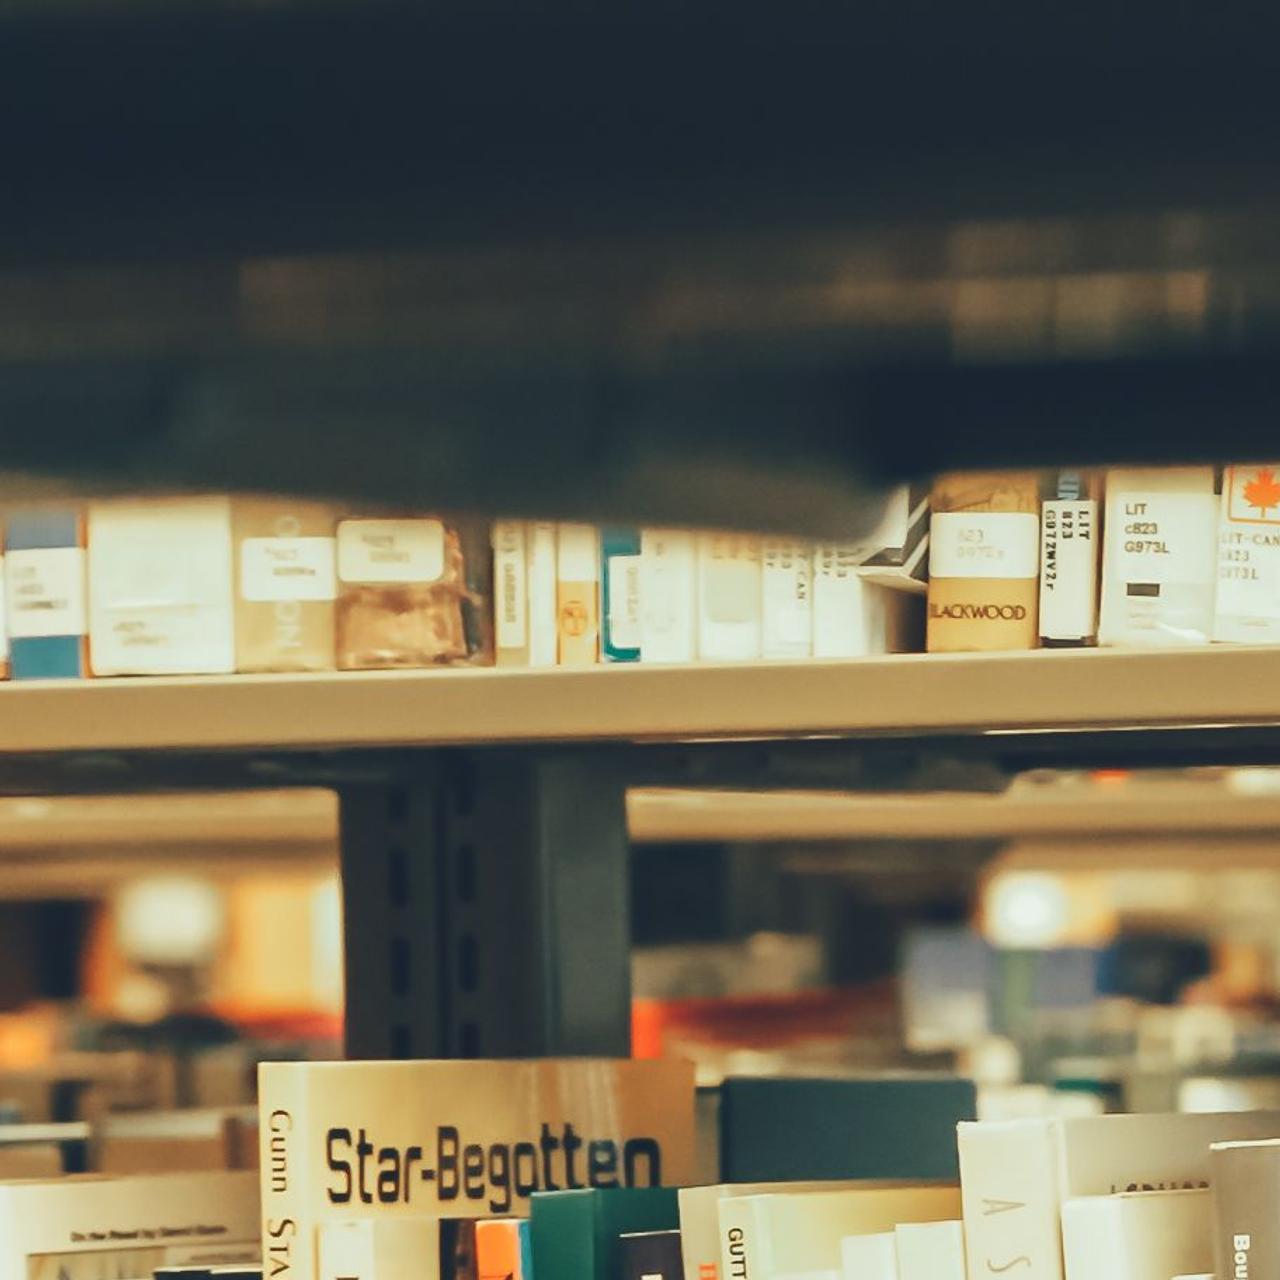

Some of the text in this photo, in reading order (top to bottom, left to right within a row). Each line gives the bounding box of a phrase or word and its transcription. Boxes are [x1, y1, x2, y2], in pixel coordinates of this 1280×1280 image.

[1126, 503, 1147, 515] LIT
[1078, 510, 1090, 539] LIT
[1125, 522, 1158, 535] c823
[269, 1109, 292, 1193] Gunn
[326, 1122, 661, 1213] Star-Begotten
